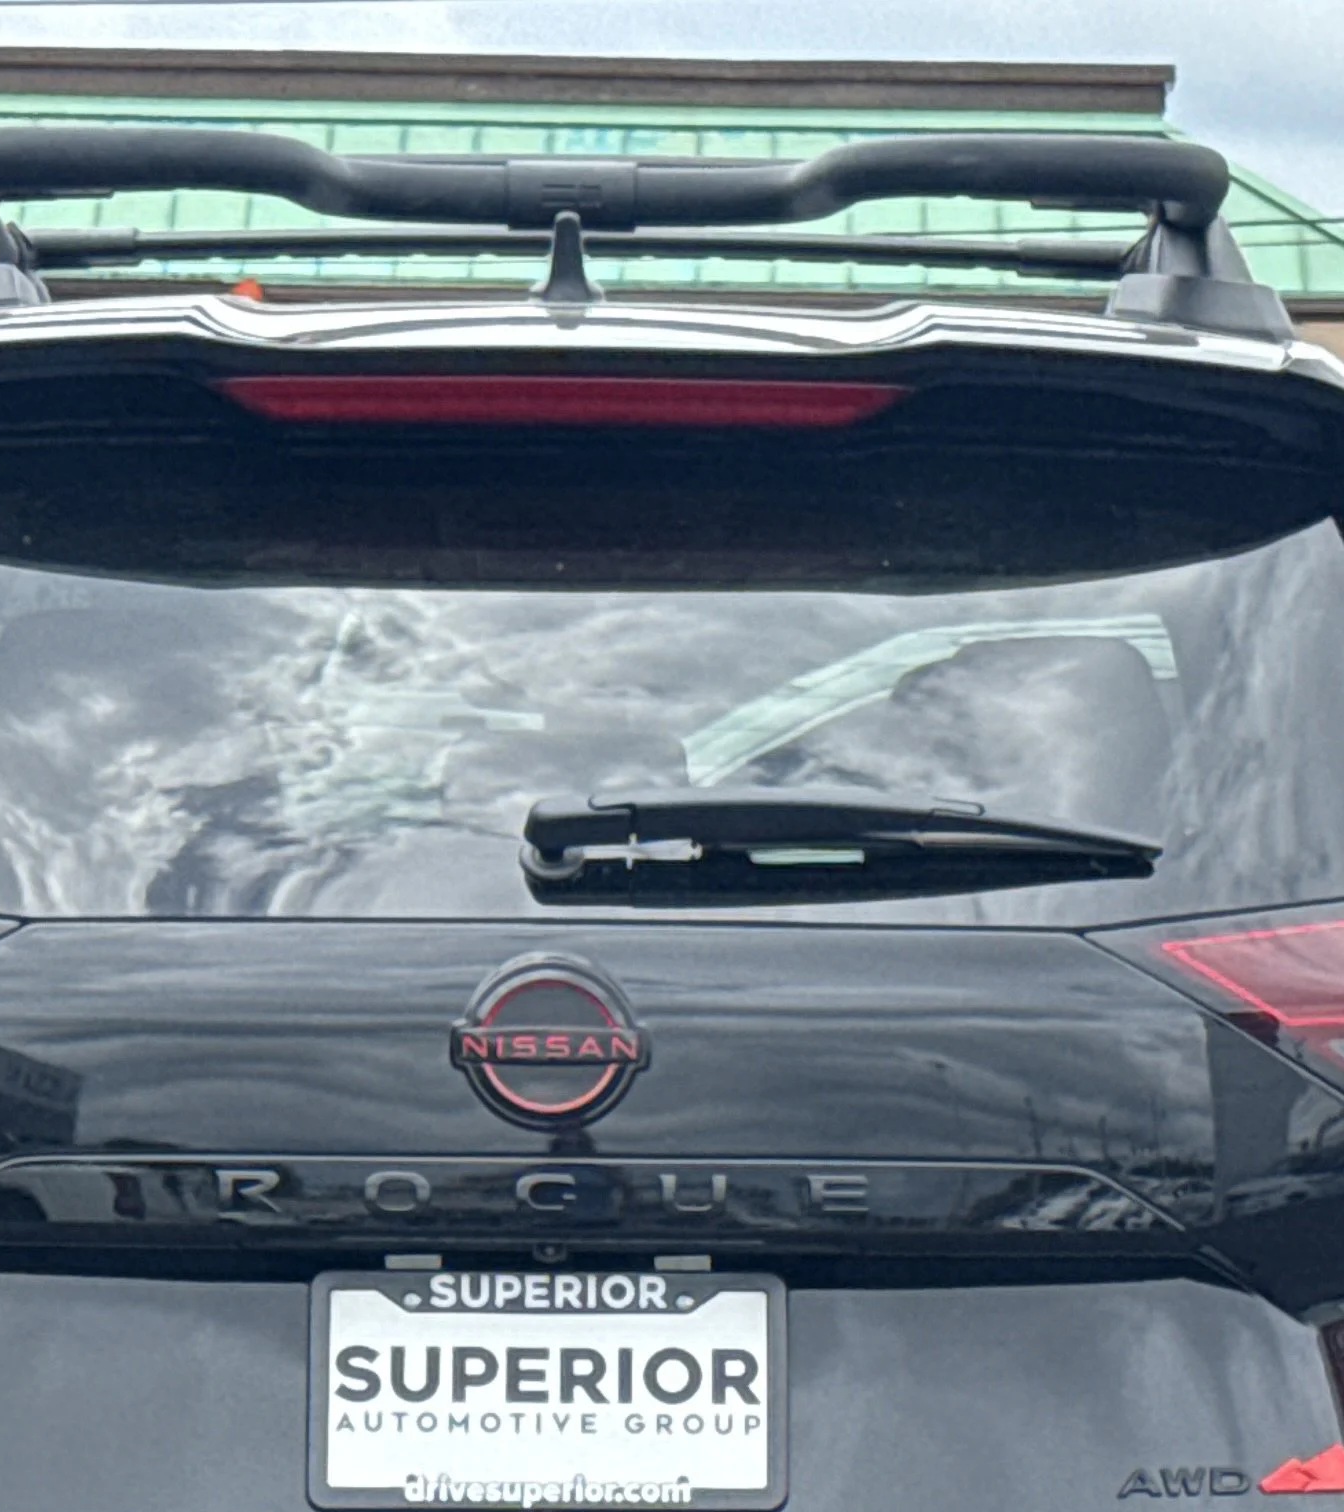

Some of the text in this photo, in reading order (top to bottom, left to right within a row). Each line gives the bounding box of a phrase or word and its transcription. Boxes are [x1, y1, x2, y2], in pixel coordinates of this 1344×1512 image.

[460, 1034, 638, 1060] NISSAN
[215, 1169, 869, 1213] ROGUE
[429, 1273, 668, 1310] SUPERIOR
[334, 1345, 762, 1405] SUPERIOR
[335, 1411, 762, 1436] AUTOMOTIVE GROUP
[404, 1474, 692, 1508] drivesuperior.com
[1116, 1466, 1251, 1499] AWD
